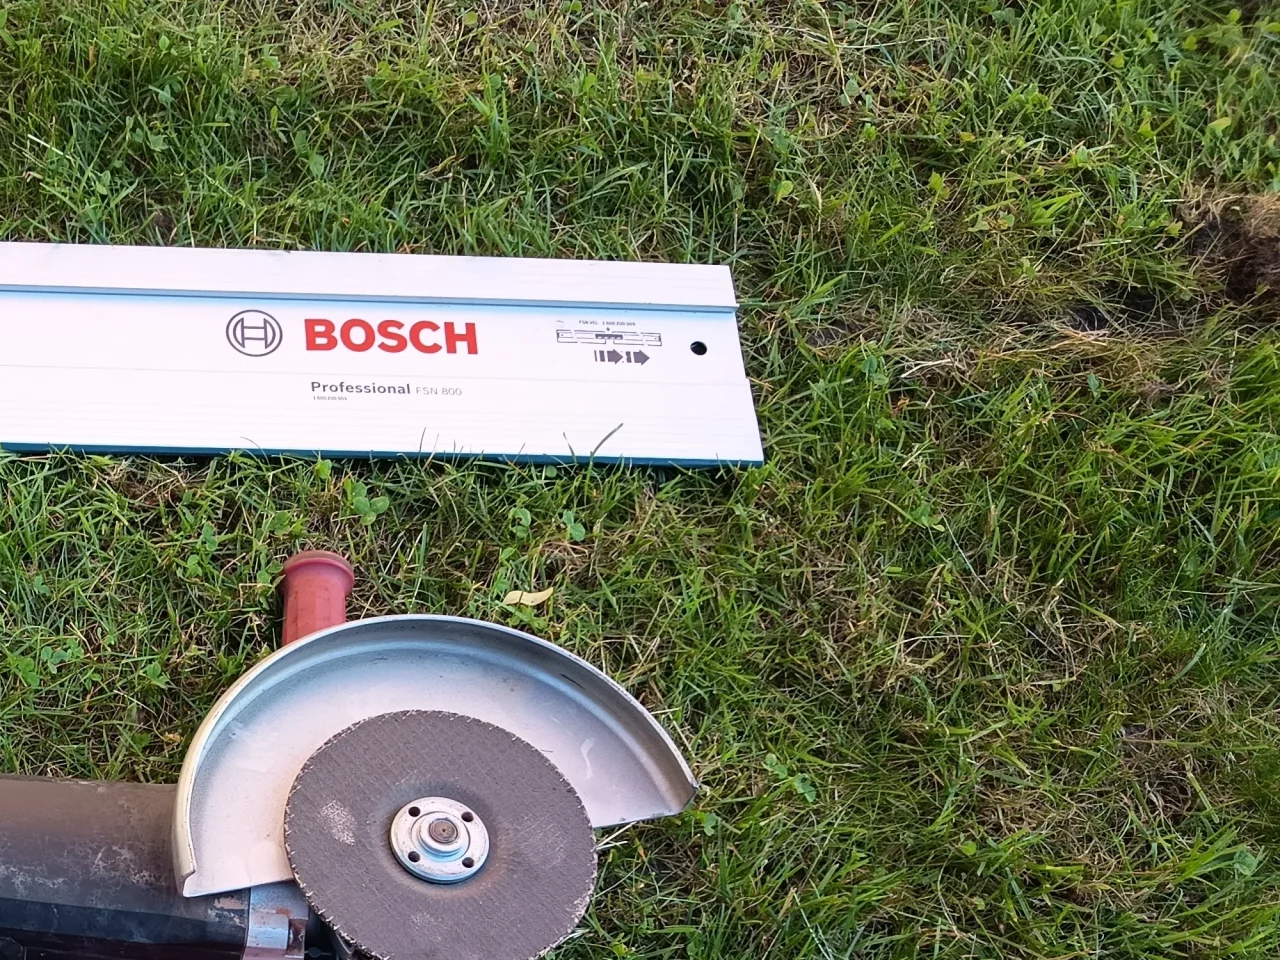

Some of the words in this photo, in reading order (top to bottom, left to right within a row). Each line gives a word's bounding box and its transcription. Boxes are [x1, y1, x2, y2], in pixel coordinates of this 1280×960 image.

[304, 318, 478, 355] BOSCH
[311, 381, 411, 394] Professional
[416, 386, 438, 395] FSN
[441, 387, 462, 396] 800
